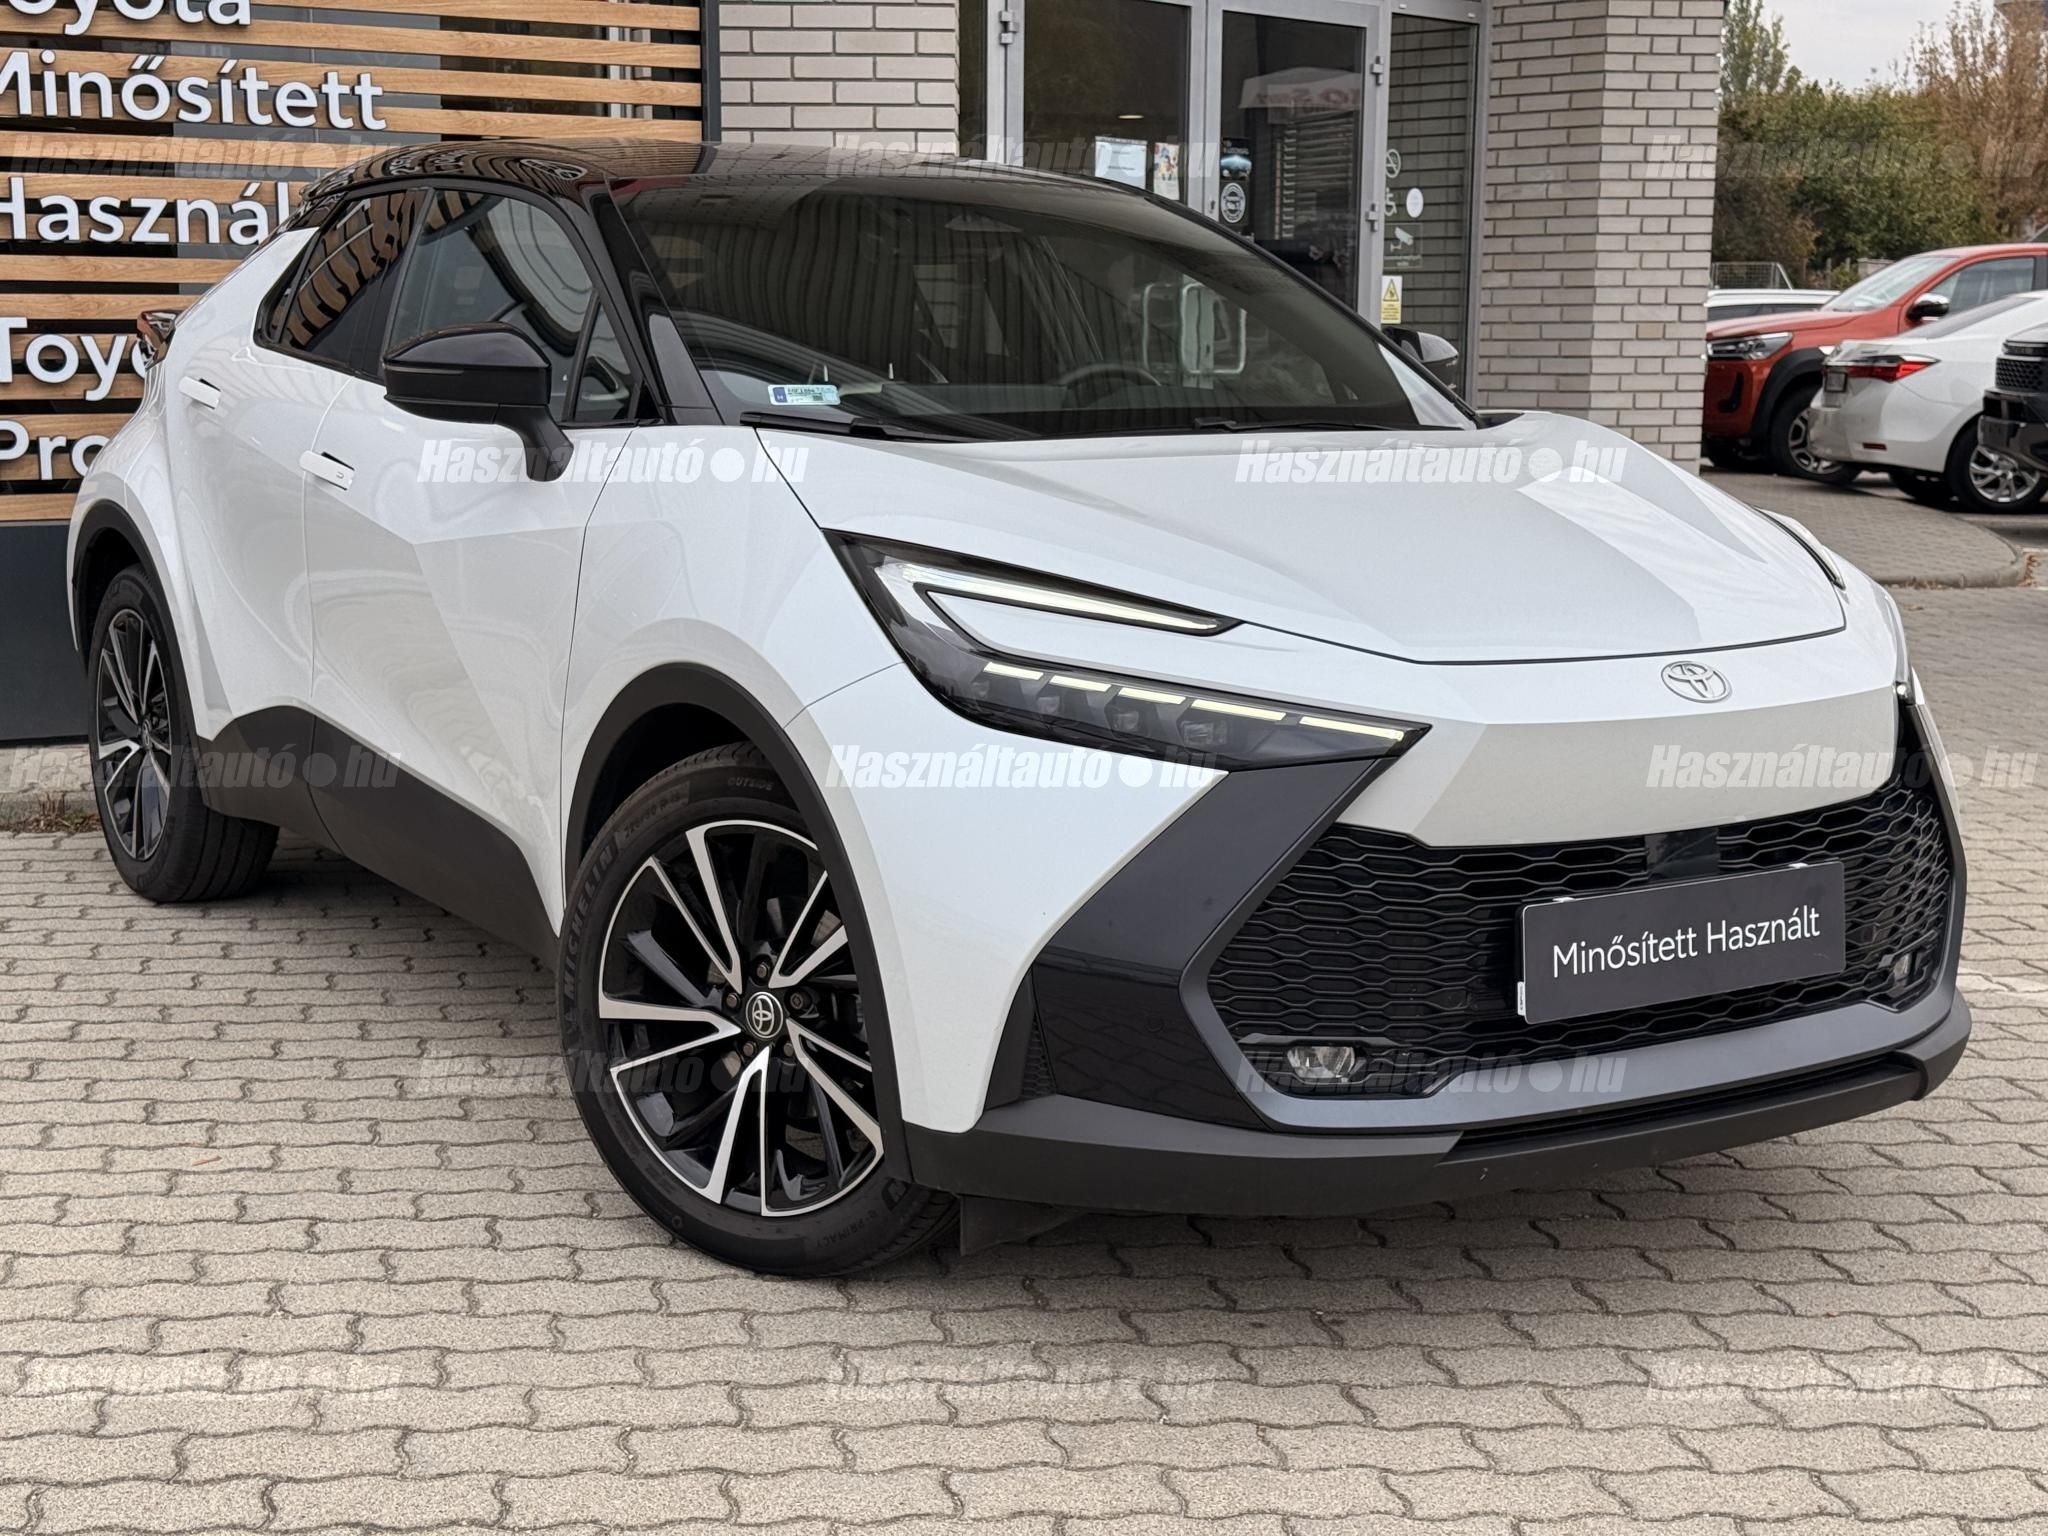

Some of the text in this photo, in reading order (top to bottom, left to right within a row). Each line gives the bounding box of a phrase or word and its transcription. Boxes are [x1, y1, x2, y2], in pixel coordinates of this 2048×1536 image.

[0, 50, 387, 131] Minősített
[0, 316, 146, 401] Toy
[563, 843, 618, 1002] MICHELIN
[1553, 904, 1821, 979] Minősített Használt
